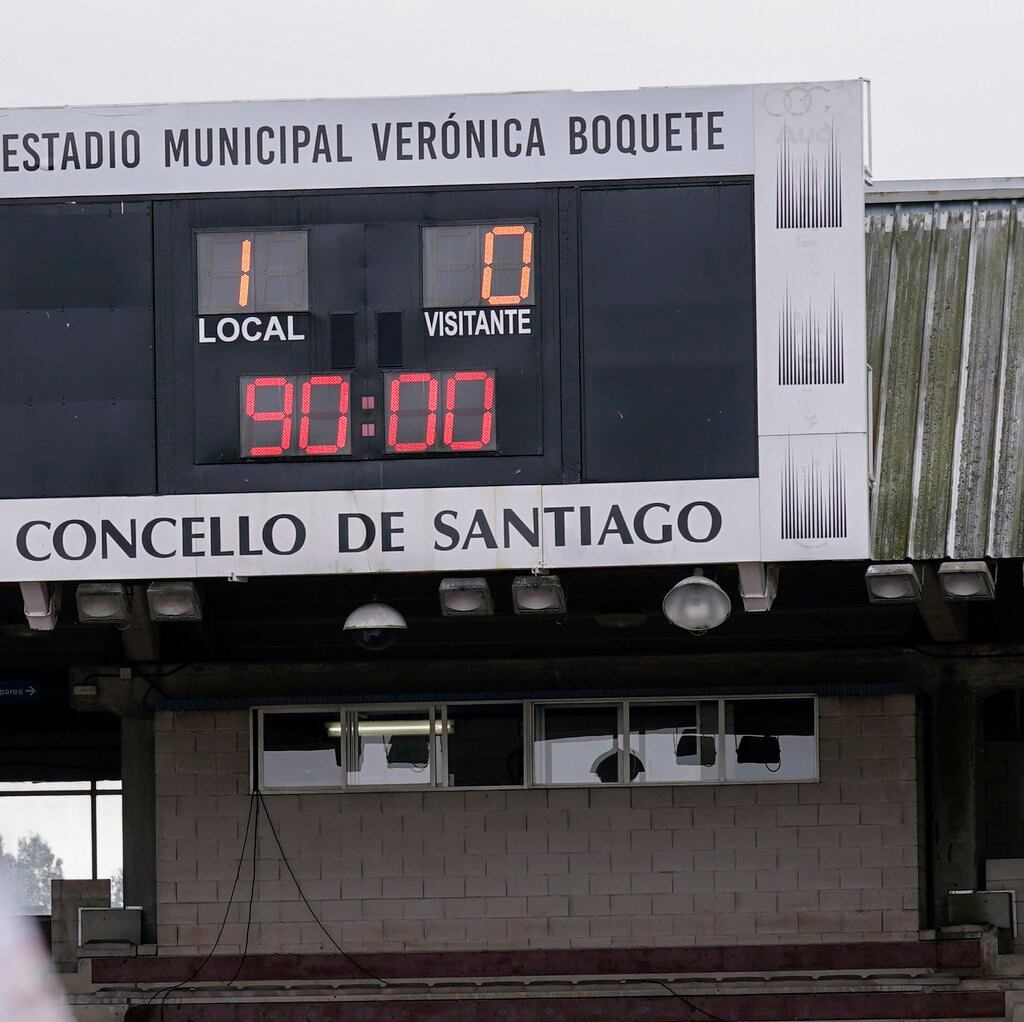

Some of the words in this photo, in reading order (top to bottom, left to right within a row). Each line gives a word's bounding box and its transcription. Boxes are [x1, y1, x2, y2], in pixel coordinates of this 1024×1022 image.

[2, 129, 141, 172] ESTADIO
[164, 123, 353, 167] MUNICIPAL
[371, 112, 546, 162] VERÓNICA
[570, 110, 726, 155] BOQUETE
[239, 240, 252, 307] 1
[481, 225, 533, 306] 0
[198, 312, 305, 343] LOCAL
[423, 308, 532, 337] VISITANTE
[245, 371, 494, 457] 90:00
[15, 511, 307, 563] CONCELLO
[338, 511, 405, 554] DE
[433, 500, 723, 552] SANTIAGO
